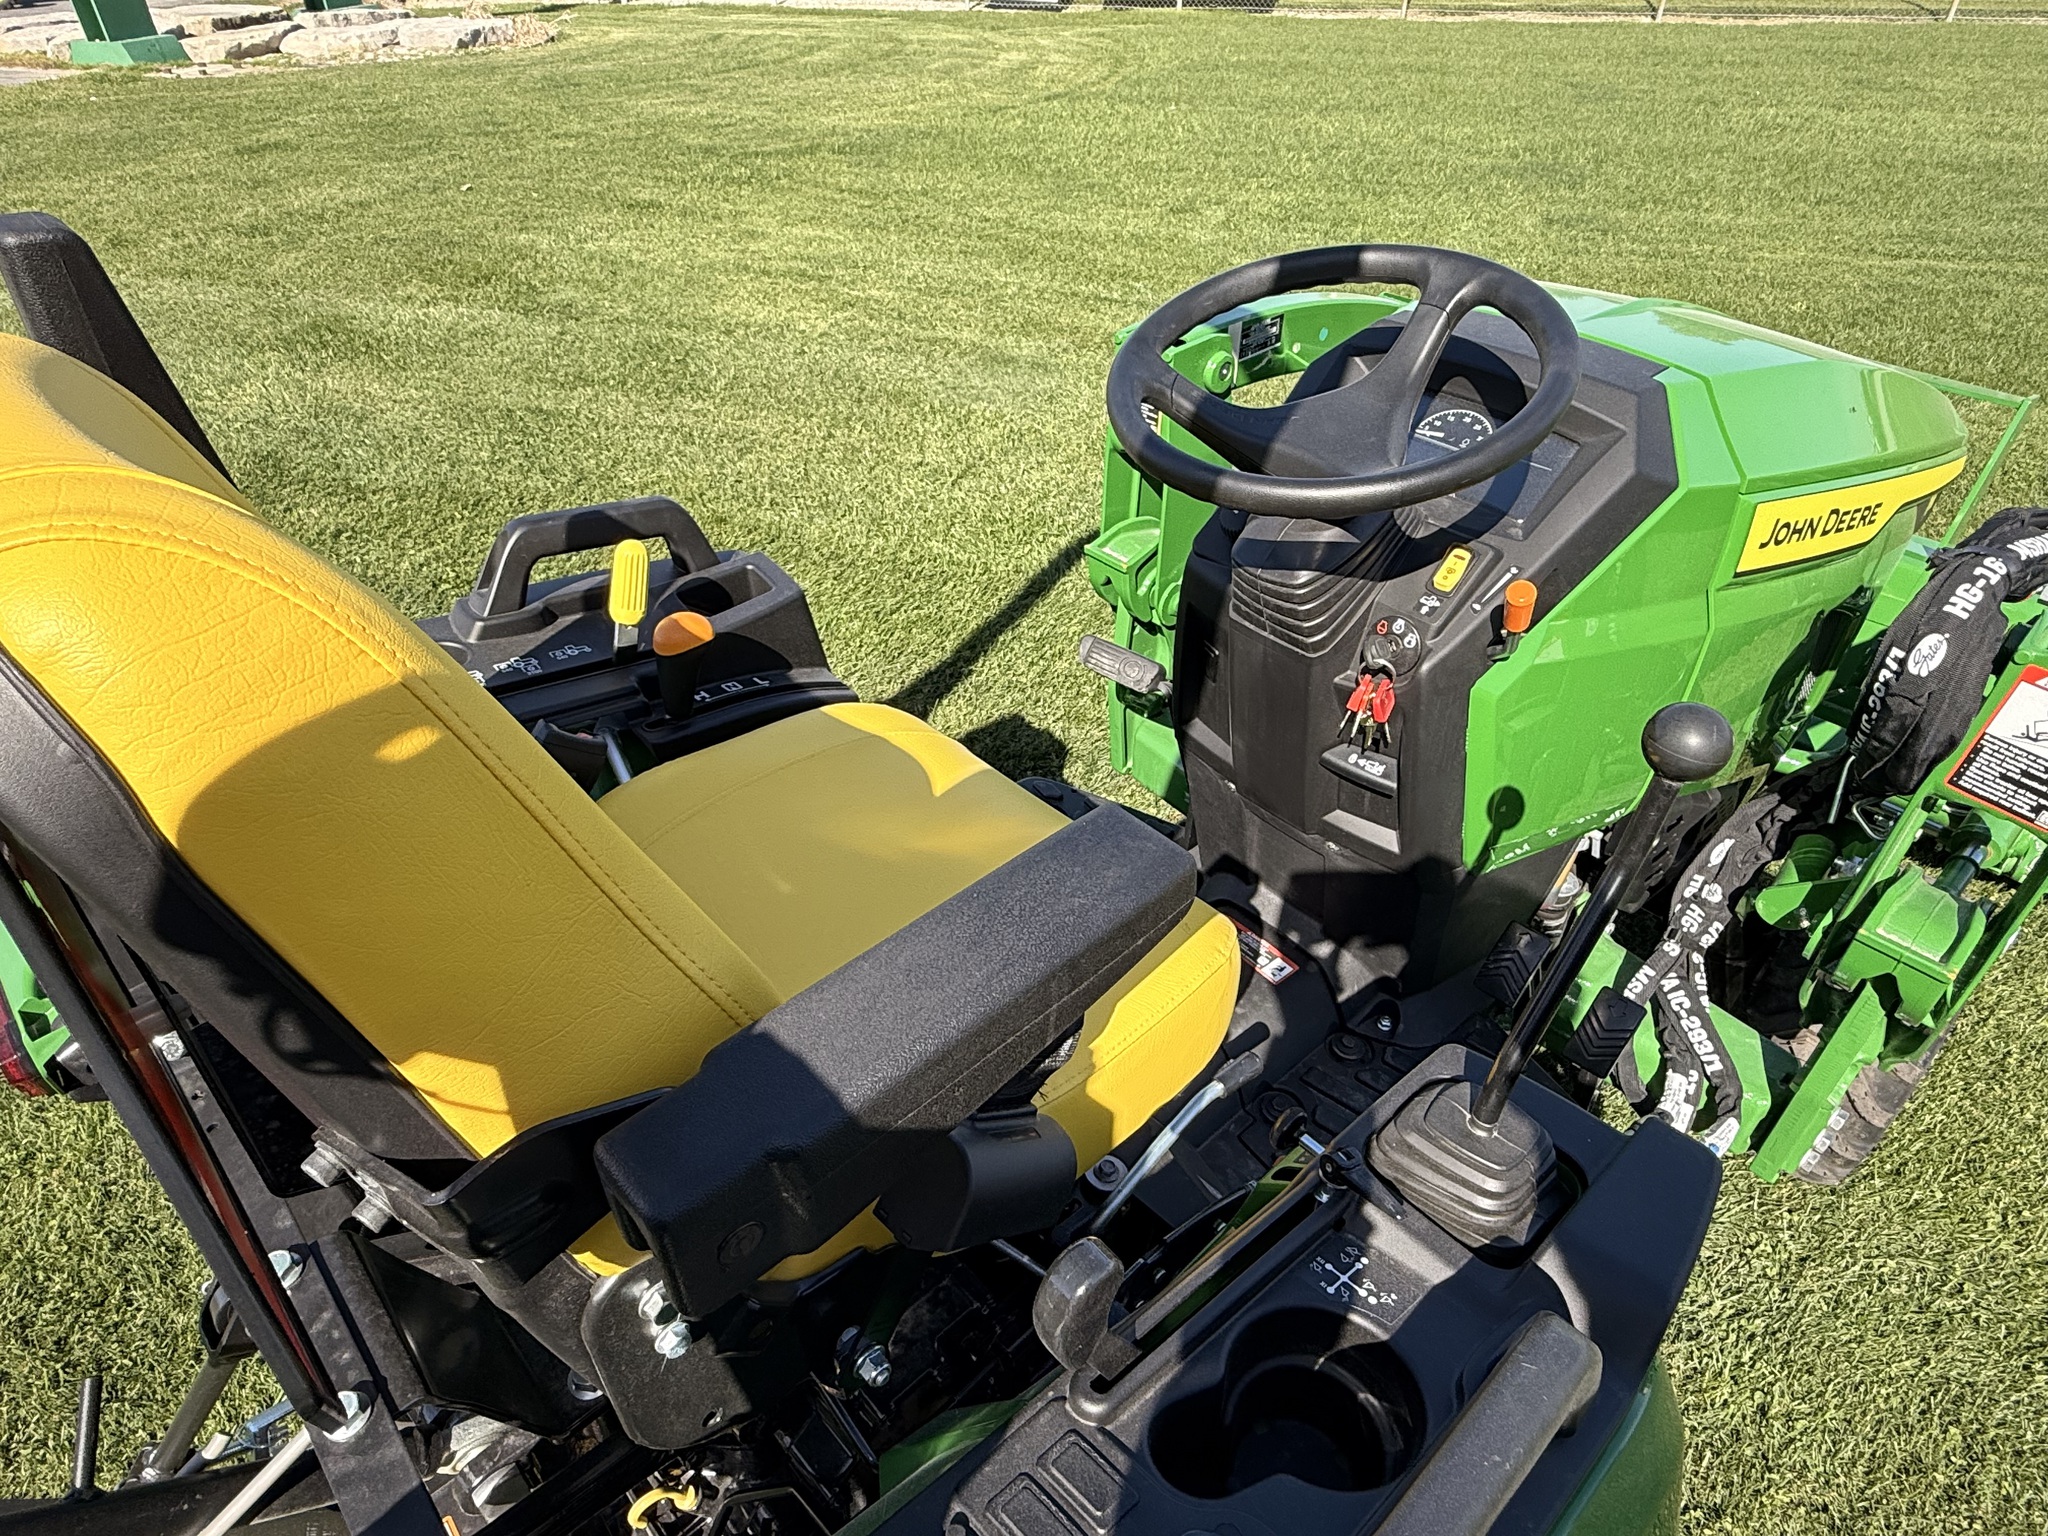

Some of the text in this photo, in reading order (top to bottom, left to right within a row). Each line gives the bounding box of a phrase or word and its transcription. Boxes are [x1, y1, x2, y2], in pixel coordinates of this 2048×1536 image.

[1758, 502, 1884, 550] JOHN DEERE
[1943, 557, 2007, 620] HG-16
[1666, 989, 1724, 1077] IC-293/1
